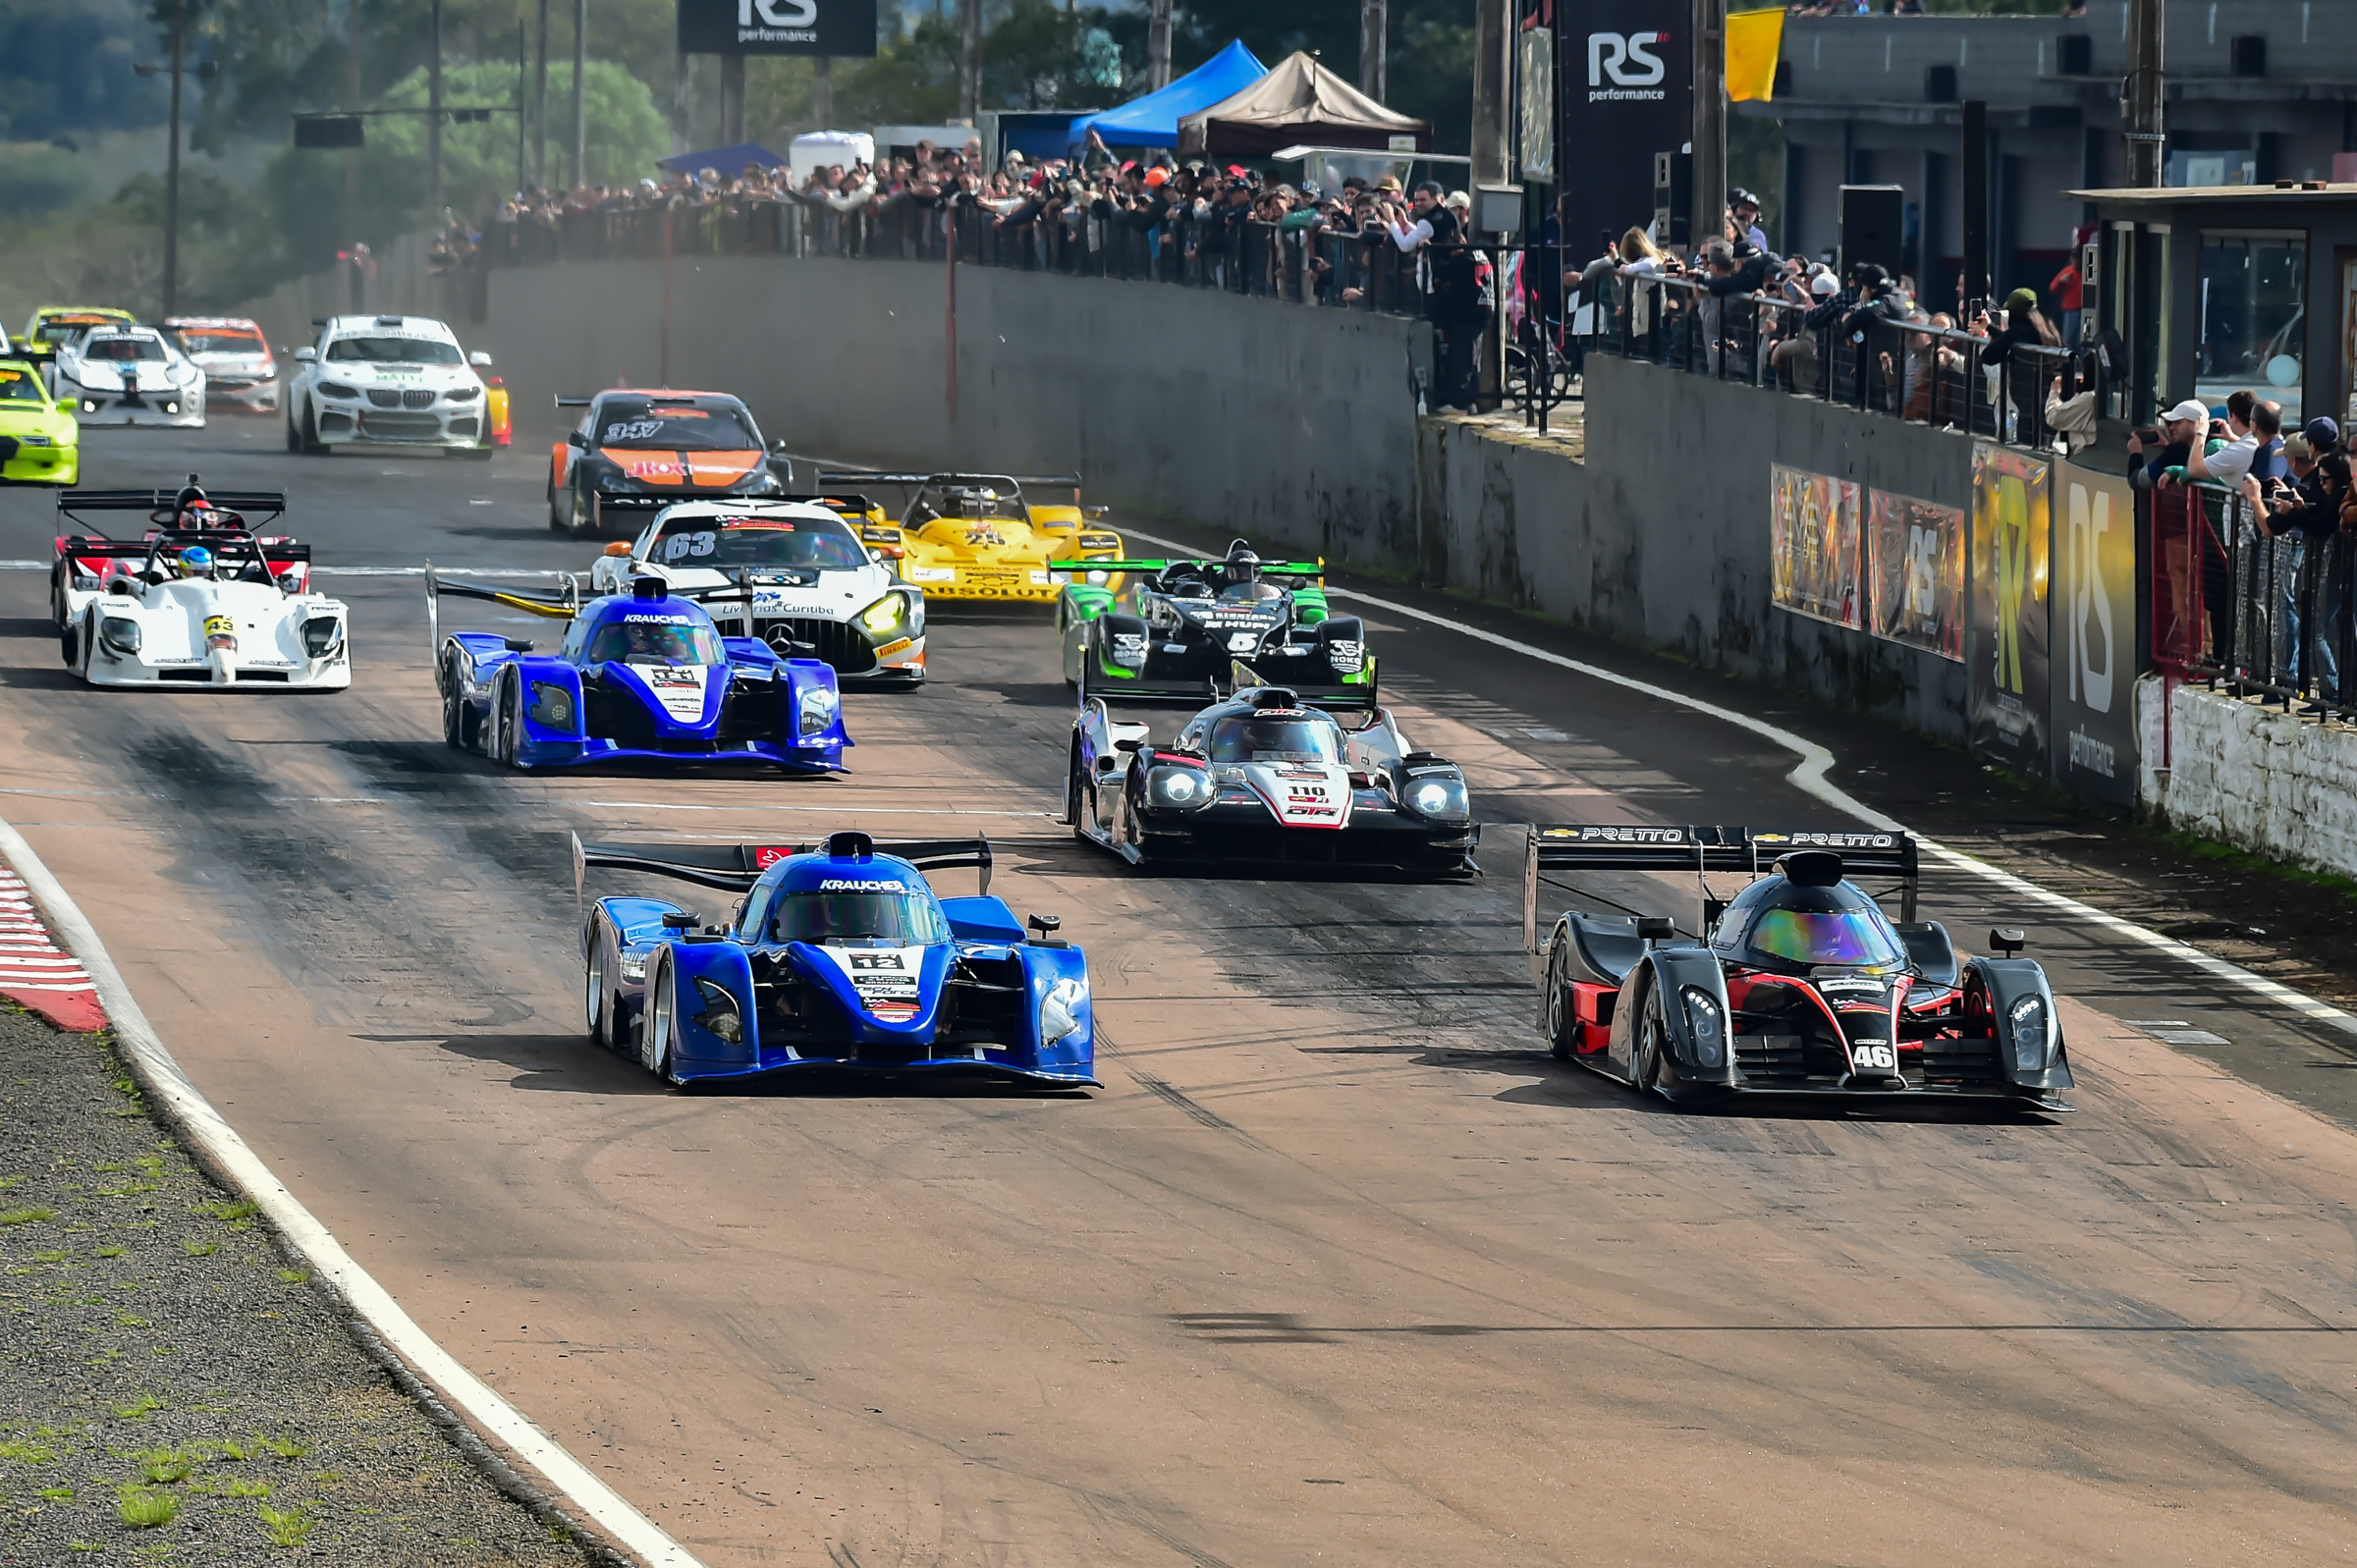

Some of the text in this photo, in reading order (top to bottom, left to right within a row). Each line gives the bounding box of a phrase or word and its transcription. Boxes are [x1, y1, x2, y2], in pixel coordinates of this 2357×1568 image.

[739, 27, 817, 43] performance
[1588, 31, 1665, 86] RS
[1589, 88, 1665, 103] performance
[665, 531, 716, 560] 63
[2069, 482, 2112, 713] RS
[722, 603, 834, 616] Livrias Curitiba
[207, 621, 234, 631] 43
[624, 614, 689, 624] KRAUCHER
[879, 638, 908, 657] PIRELLI
[2069, 723, 2114, 778] performance
[1288, 785, 1326, 796] 110
[1582, 827, 1682, 842] PRETTO
[1791, 832, 1891, 847] PRETTO
[820, 879, 904, 891] KRAUCHER
[857, 958, 898, 968] 12
[1853, 1046, 1893, 1068] 46
